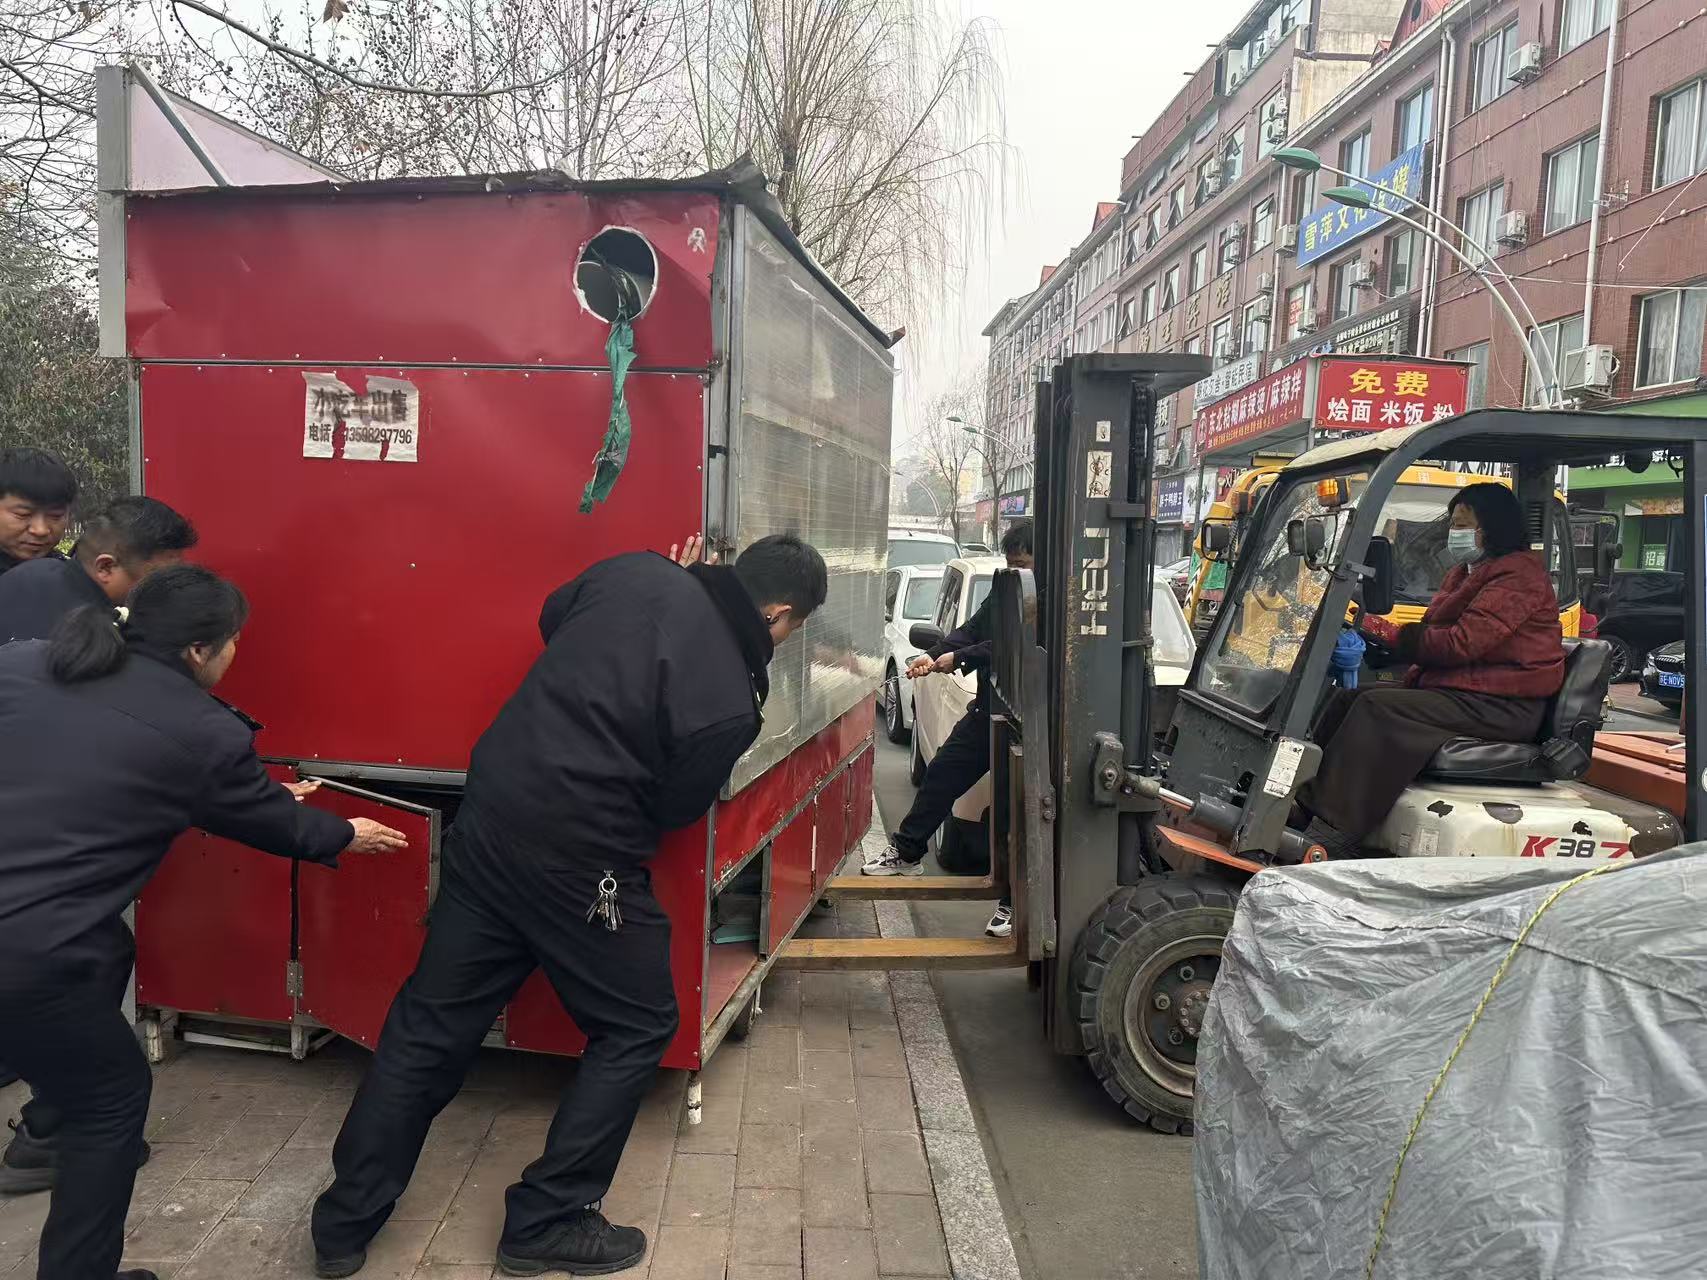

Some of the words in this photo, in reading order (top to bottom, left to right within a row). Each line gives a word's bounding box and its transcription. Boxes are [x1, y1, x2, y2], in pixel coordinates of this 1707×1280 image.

[1349, 368, 1429, 397] 免费
[1327, 397, 1373, 424] 烩面
[1380, 400, 1425, 425] 米饭
[309, 424, 332, 443] 电话
[1081, 527, 1110, 636] HELI
